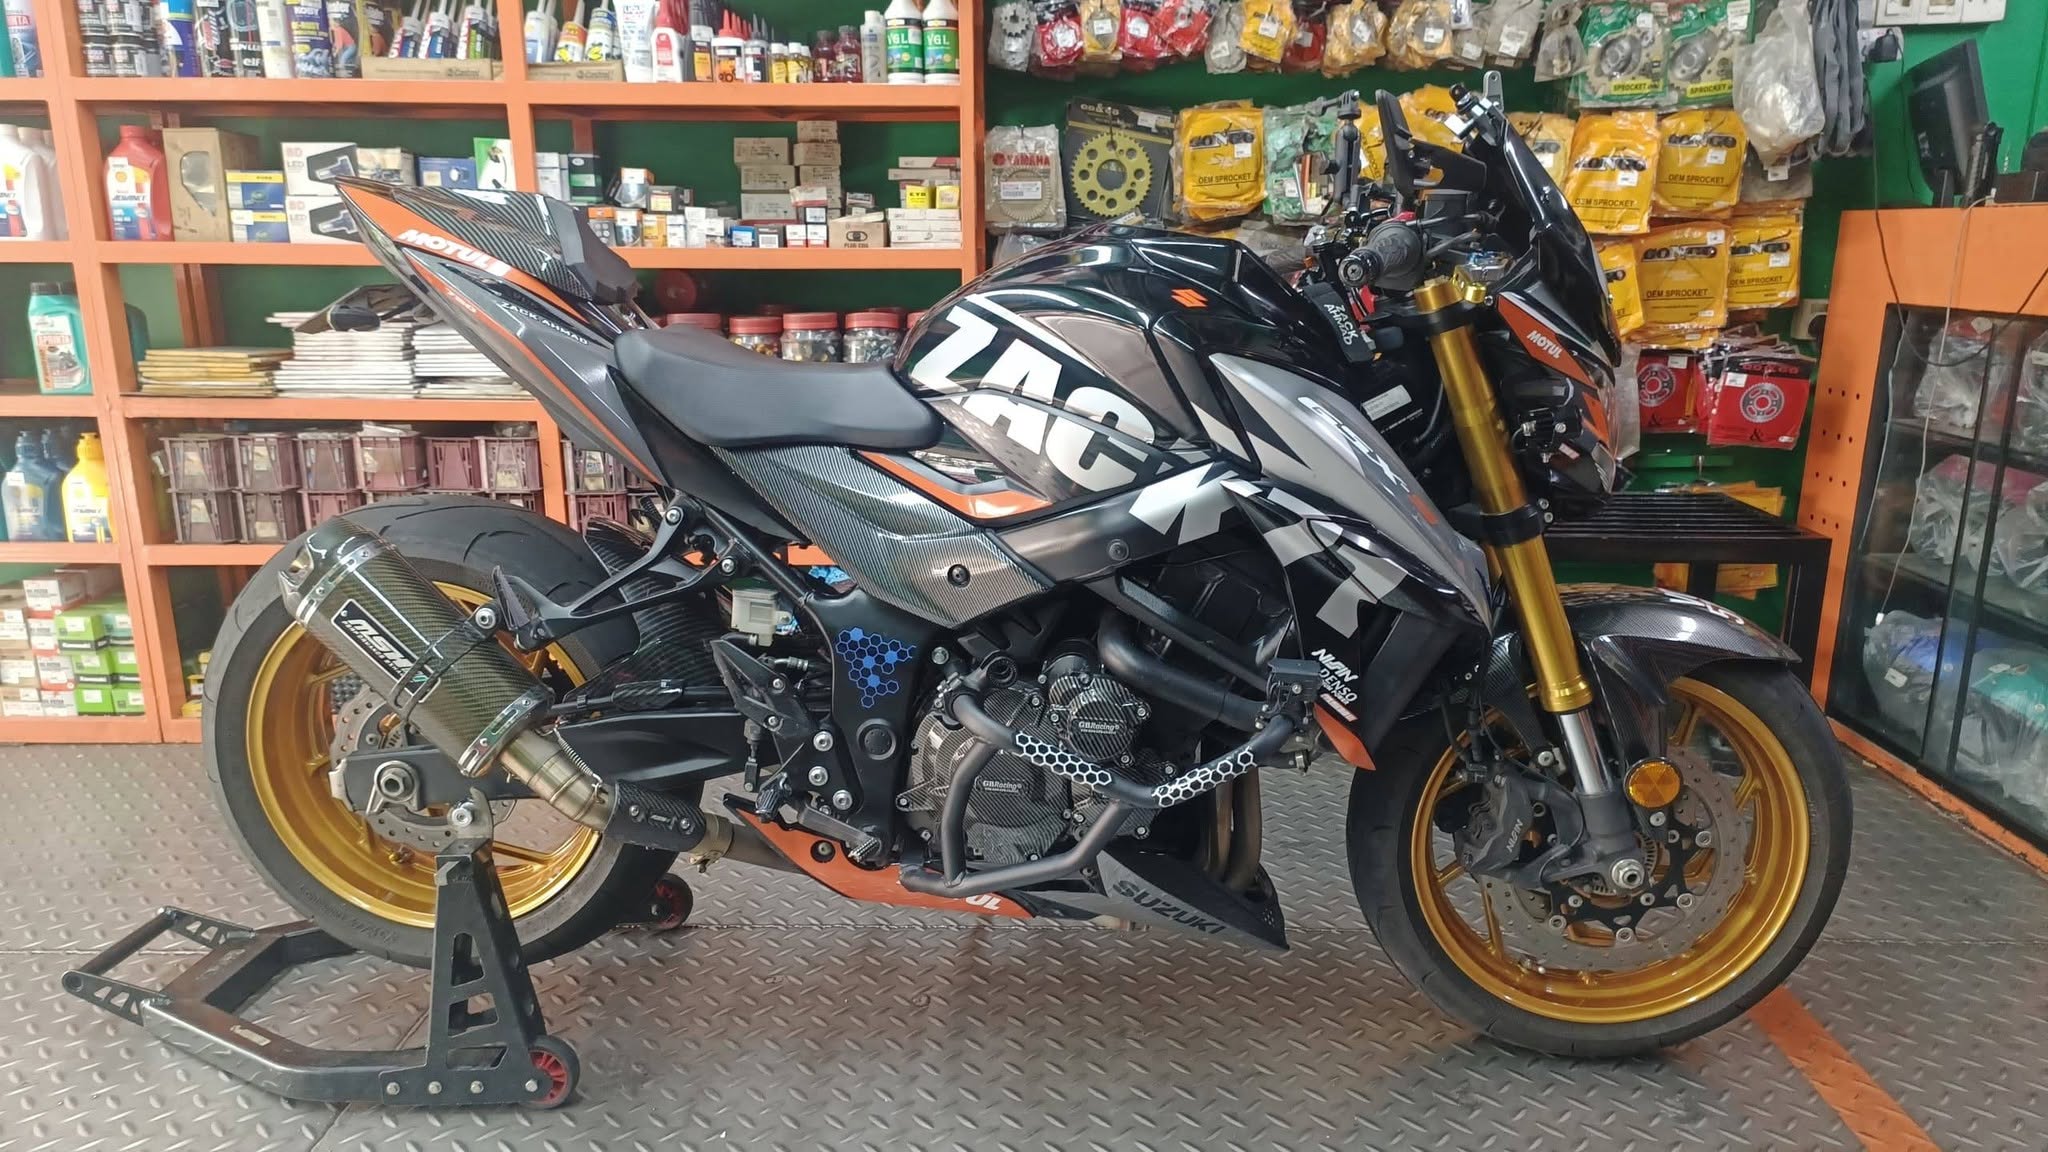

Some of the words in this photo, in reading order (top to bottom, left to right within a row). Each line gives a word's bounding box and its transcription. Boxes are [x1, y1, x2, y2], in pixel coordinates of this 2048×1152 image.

[1006, 153, 1051, 166] YAMAHA
[1215, 172, 1251, 183] SPROCKET
[1686, 174, 1725, 183] SPROCKET
[397, 228, 492, 269] MOTUL
[1665, 288, 1709, 298] SPROCKET
[500, 300, 539, 321] ZACK
[541, 318, 589, 345] AHMAD
[1335, 304, 1359, 338] ZACK
[1526, 330, 1563, 359] MOTUL
[1320, 667, 1358, 702] DENSO
[1113, 880, 1227, 934] SUZUKI
